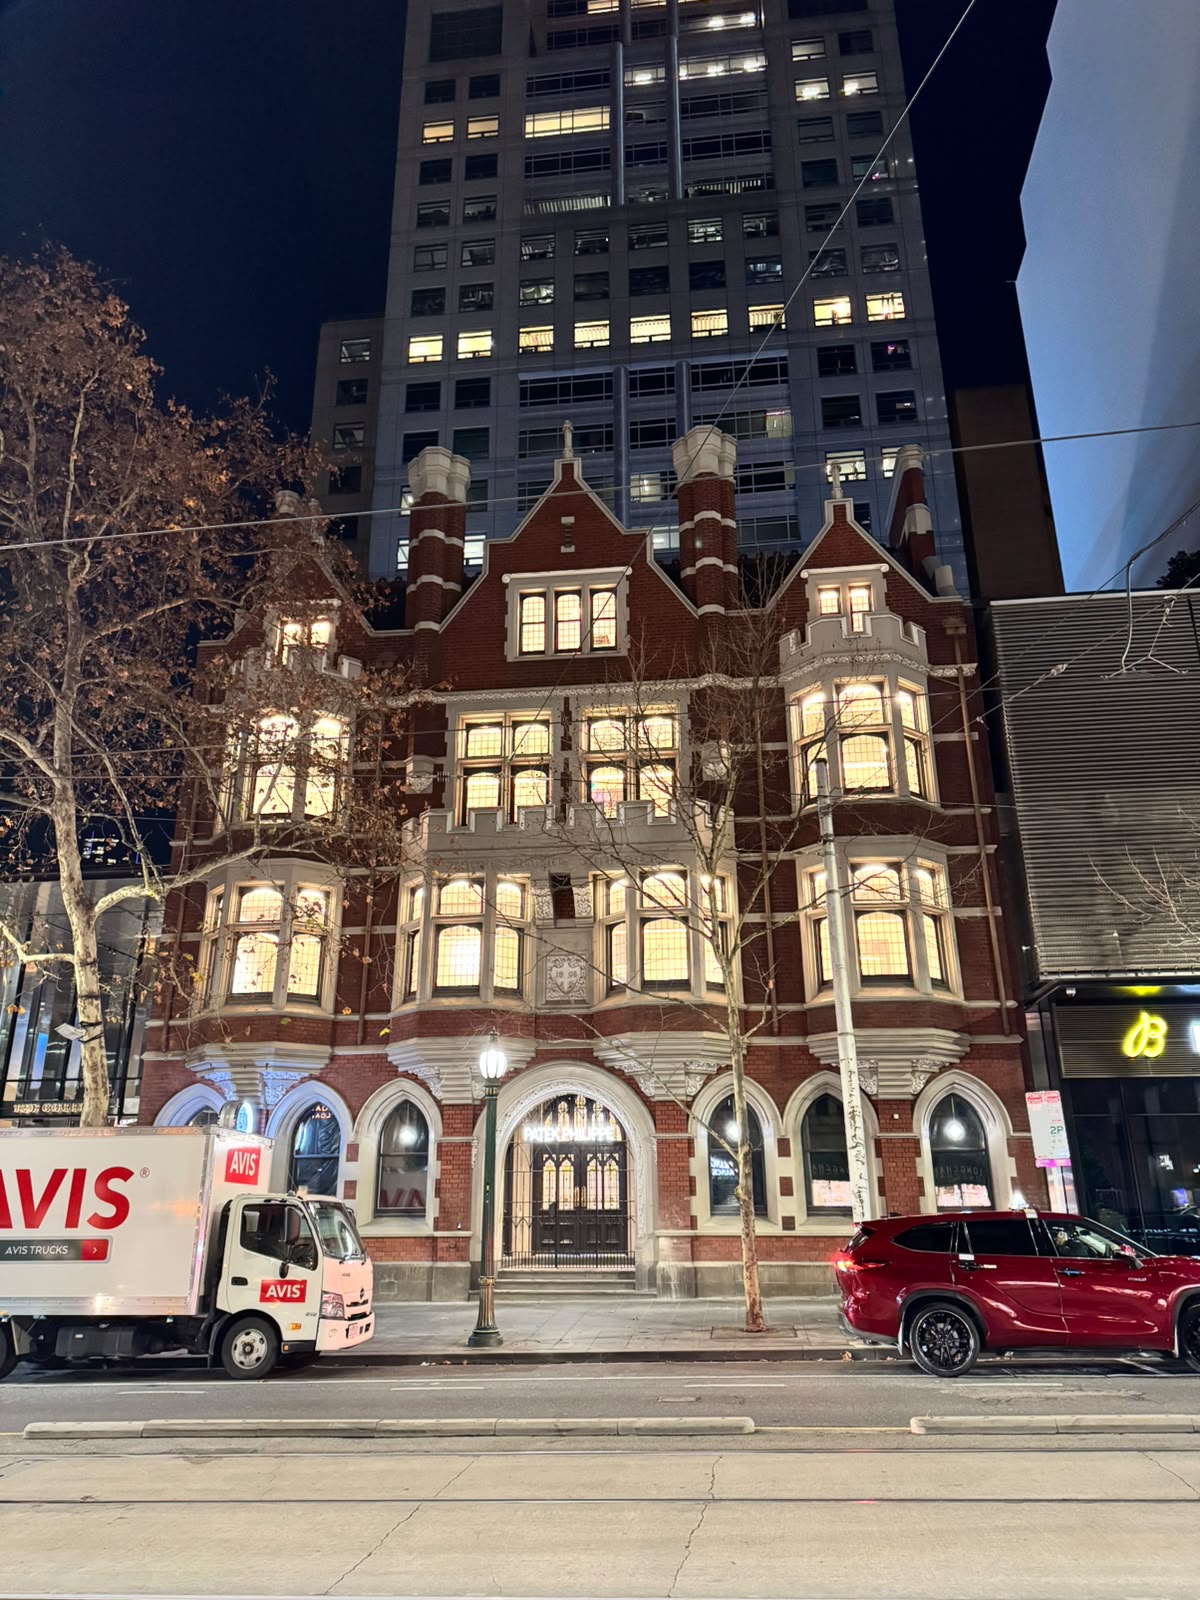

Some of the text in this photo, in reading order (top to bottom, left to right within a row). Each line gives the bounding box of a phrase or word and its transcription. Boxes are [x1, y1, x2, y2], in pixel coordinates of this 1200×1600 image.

[525, 1125, 615, 1142] PATEK PHILIPPE
[1049, 1126, 1064, 1135] 2P
[229, 1150, 257, 1177] AVIS
[4, 1245, 69, 1255] AVIS TRUCKS
[265, 1284, 301, 1299] AVIS
